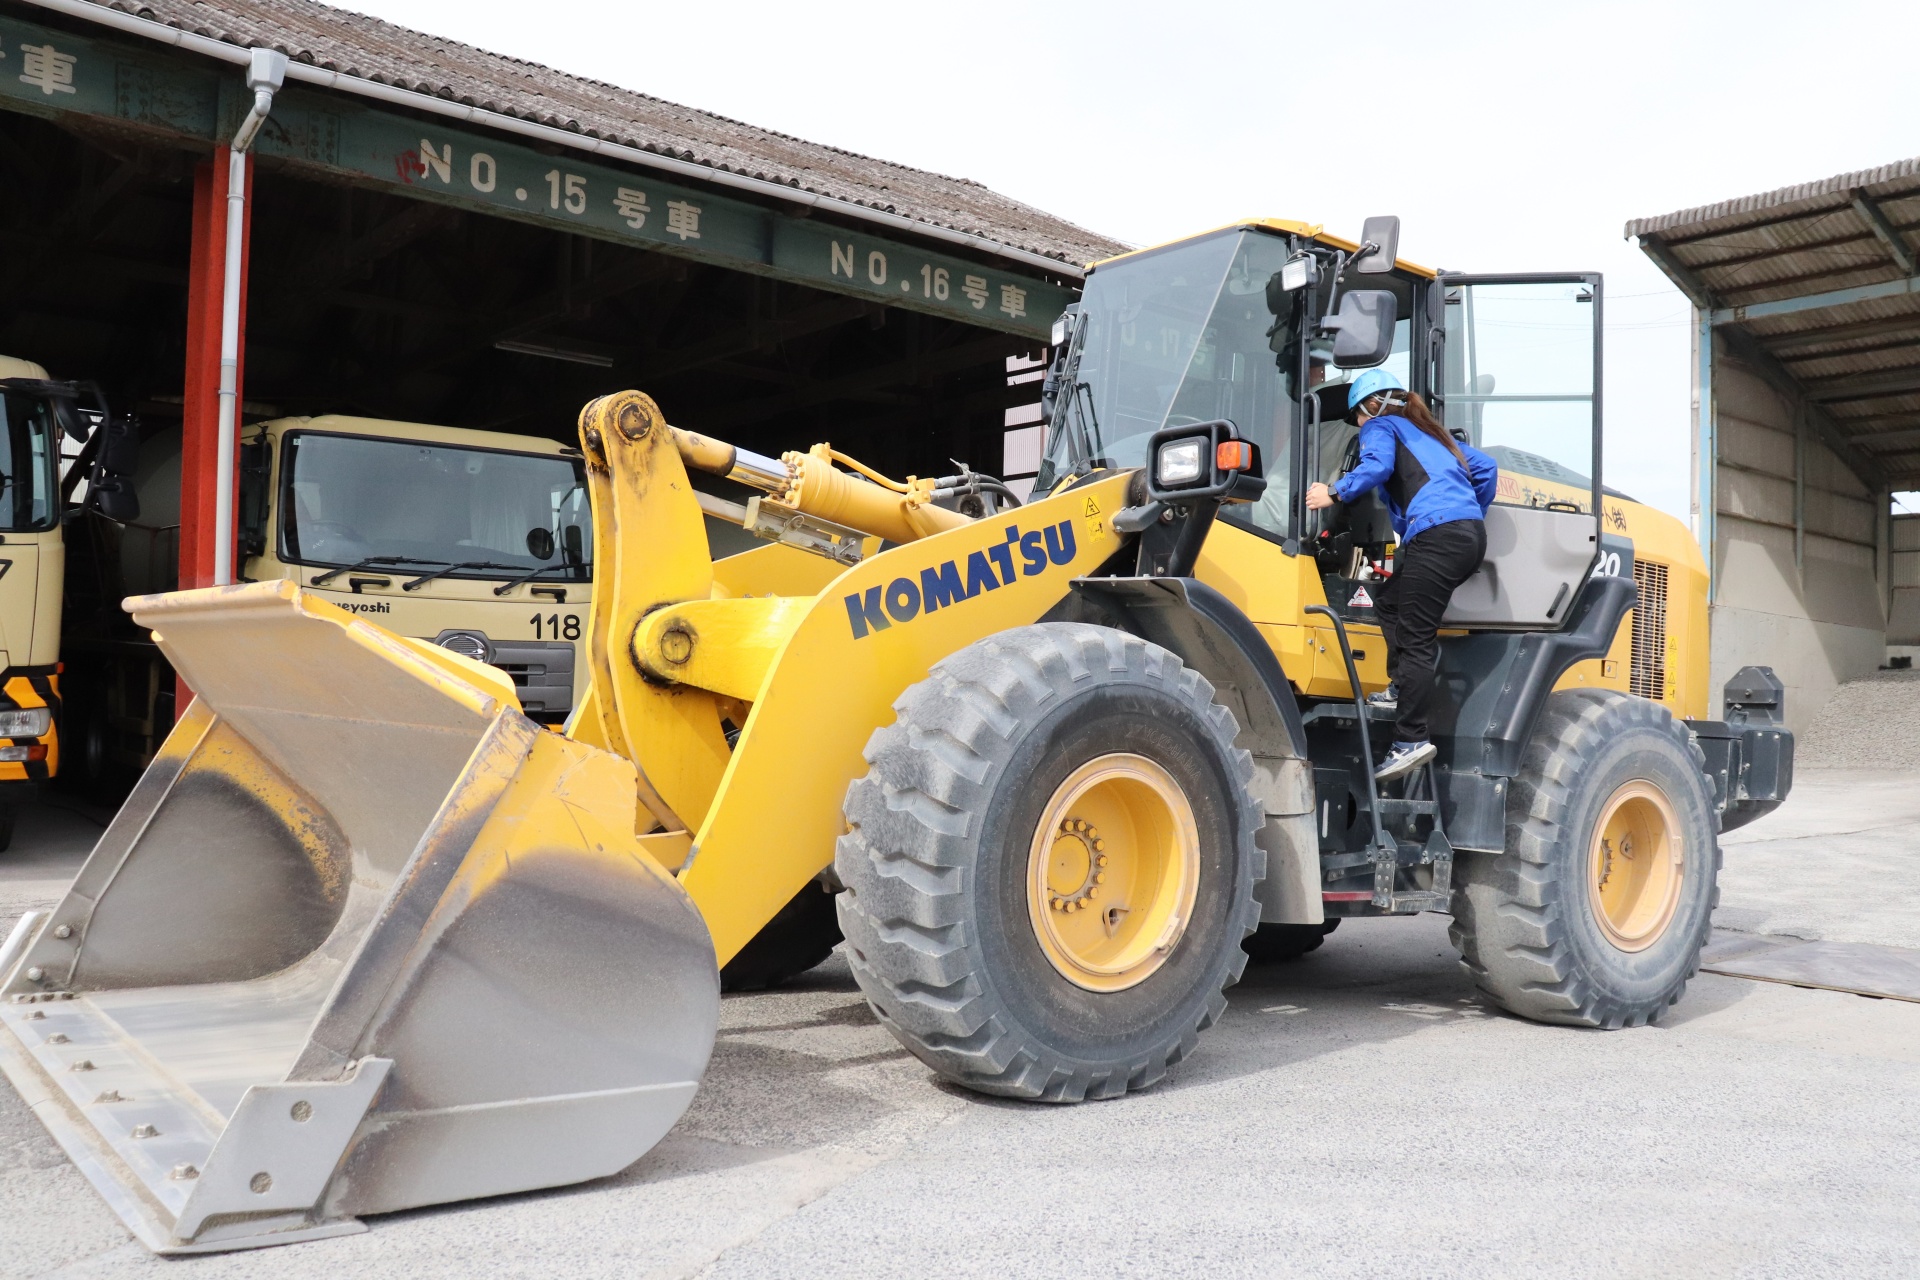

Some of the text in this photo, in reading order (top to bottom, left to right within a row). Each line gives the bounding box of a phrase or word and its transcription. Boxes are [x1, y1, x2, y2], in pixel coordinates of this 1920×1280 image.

[0, 36, 78, 95] 車
[844, 519, 1077, 640] KOMATSU
[1590, 549, 1621, 578] 20
[530, 613, 581, 640] 118
